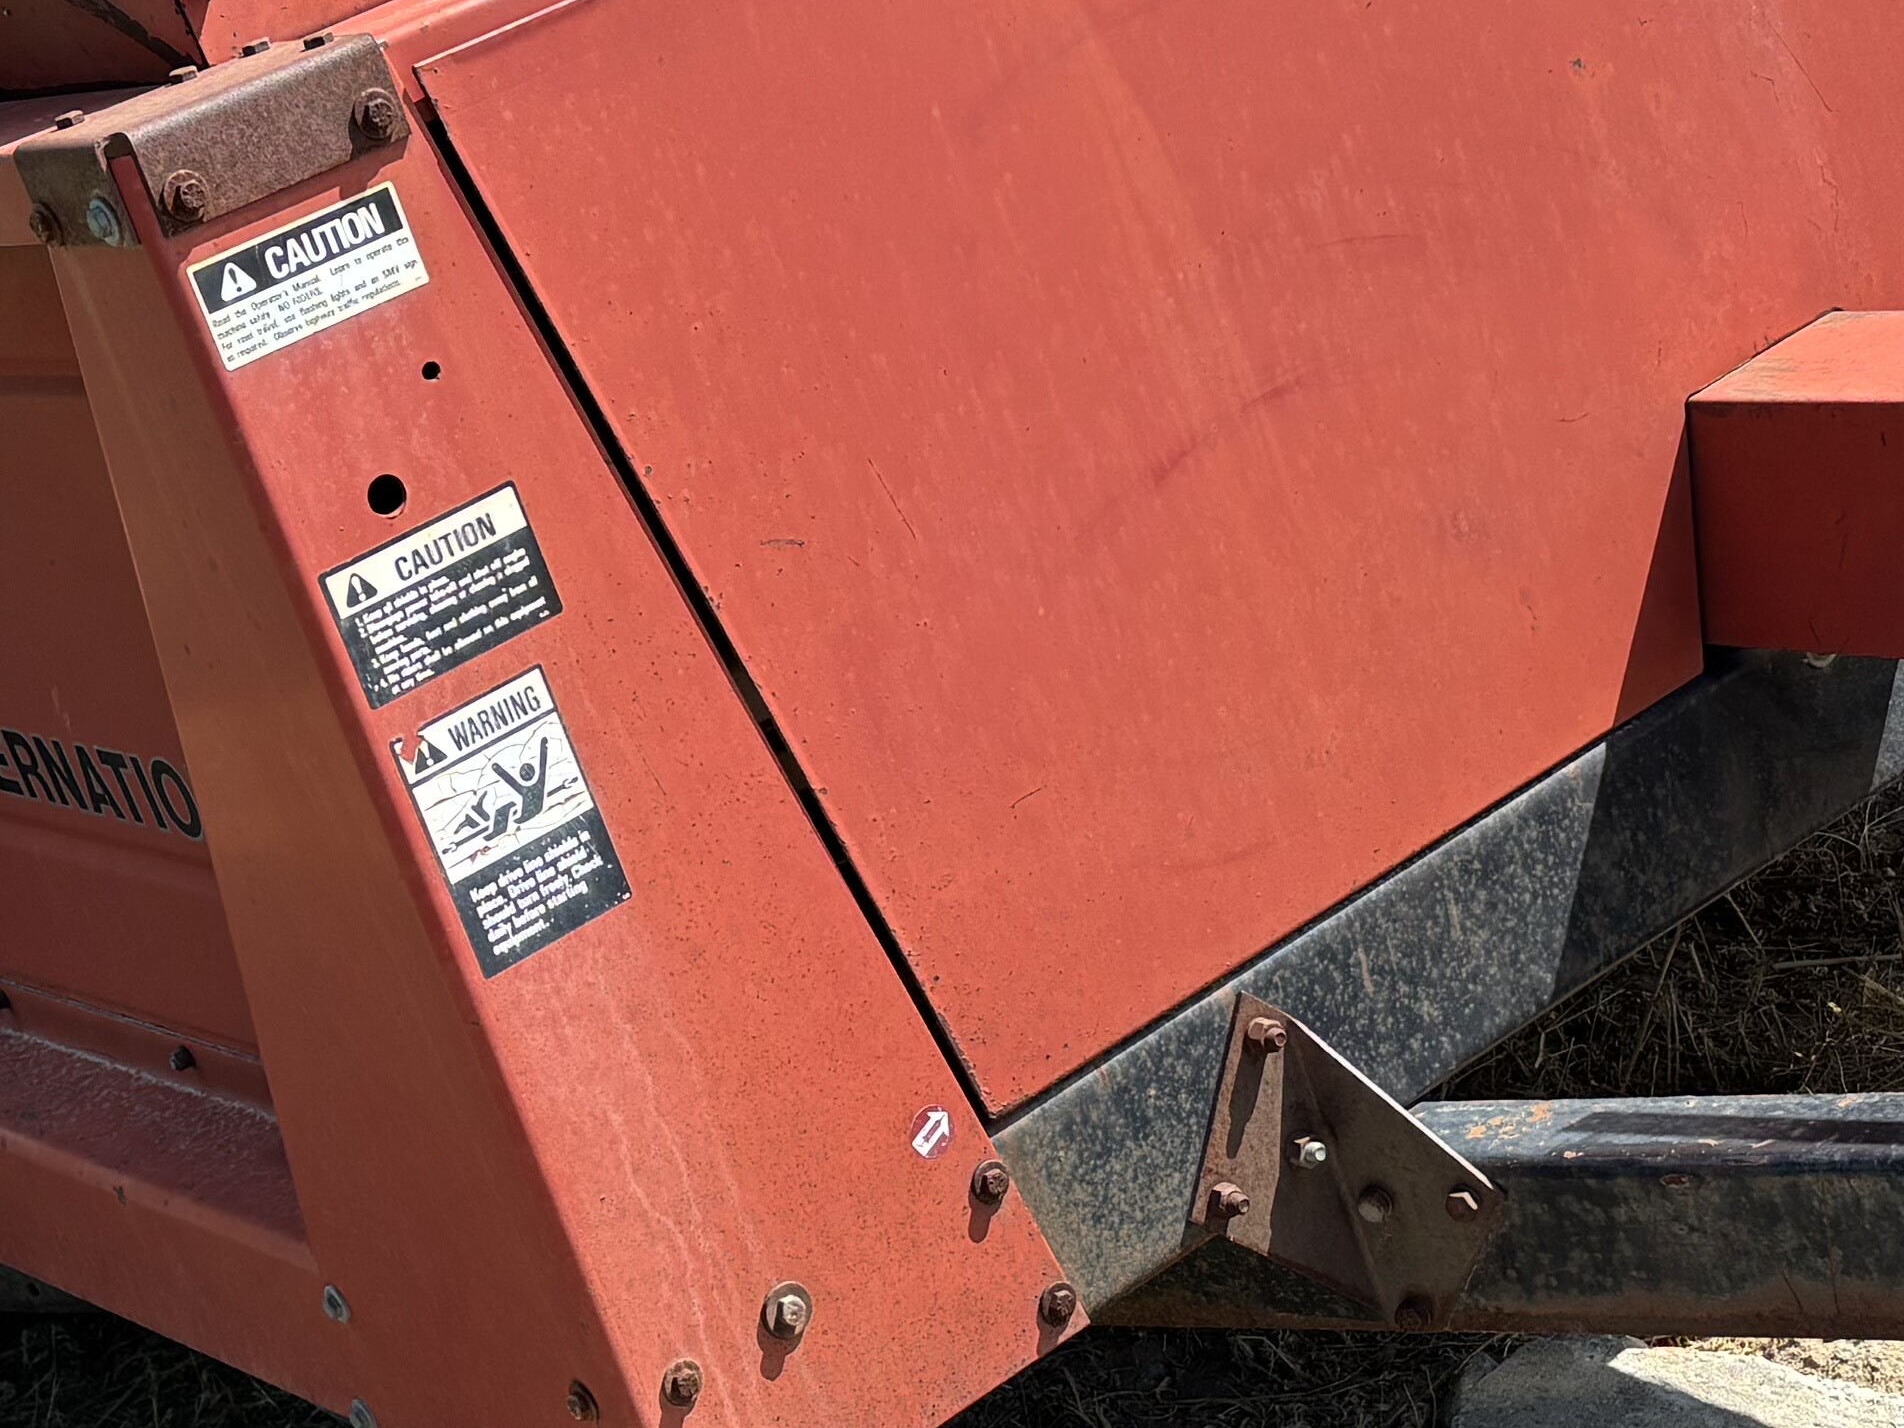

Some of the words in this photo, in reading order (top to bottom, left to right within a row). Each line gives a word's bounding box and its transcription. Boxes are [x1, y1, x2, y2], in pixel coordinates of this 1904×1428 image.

[264, 202, 385, 278] CAUTION
[394, 512, 496, 581] CAUTION
[447, 685, 541, 751] WARNING
[469, 881, 497, 903] Keep
[497, 867, 523, 887] drive
[522, 856, 543, 873] line
[543, 835, 579, 862] shields
[577, 830, 590, 842] in
[476, 892, 507, 918] place.
[506, 877, 536, 898] Drive
[534, 866, 556, 883] line
[480, 900, 516, 929] should
[516, 890, 540, 909] turn
[539, 873, 572, 897] freely.
[570, 852, 603, 879] Check
[487, 921, 512, 942] daily
[511, 903, 546, 928] before
[546, 880, 588, 909] starting
[492, 918, 550, 955] equipment.
